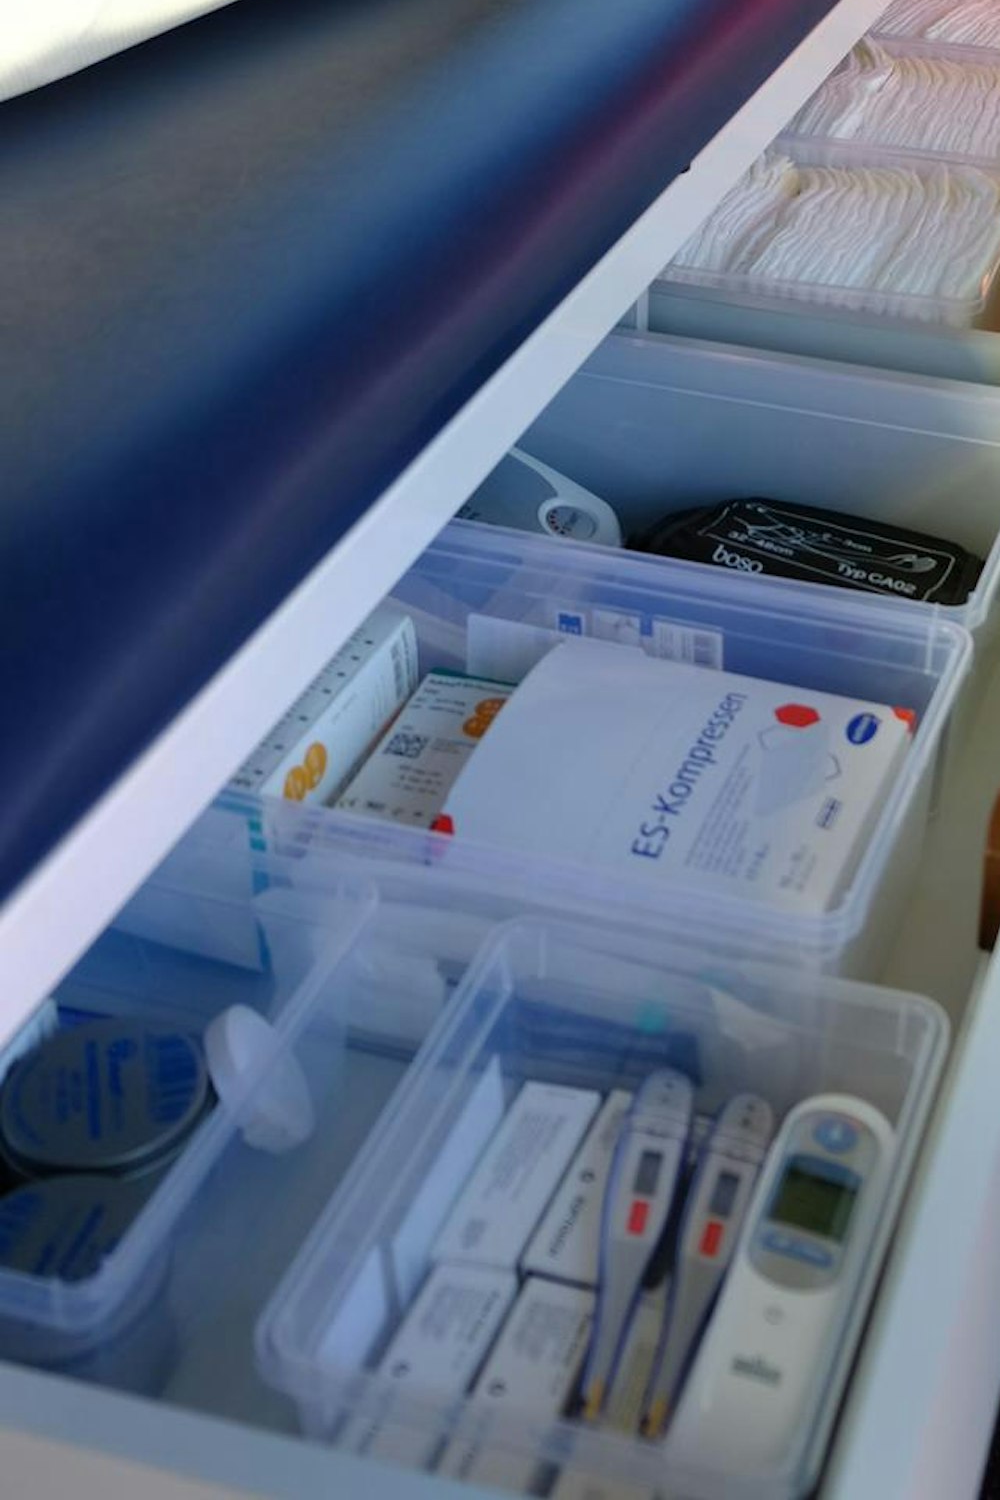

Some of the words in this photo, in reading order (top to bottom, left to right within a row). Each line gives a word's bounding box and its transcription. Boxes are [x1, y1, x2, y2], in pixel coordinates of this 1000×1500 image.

[712, 544, 764, 574] boso
[838, 562, 866, 580] Typ
[631, 692, 747, 859] ES-Kompressen
